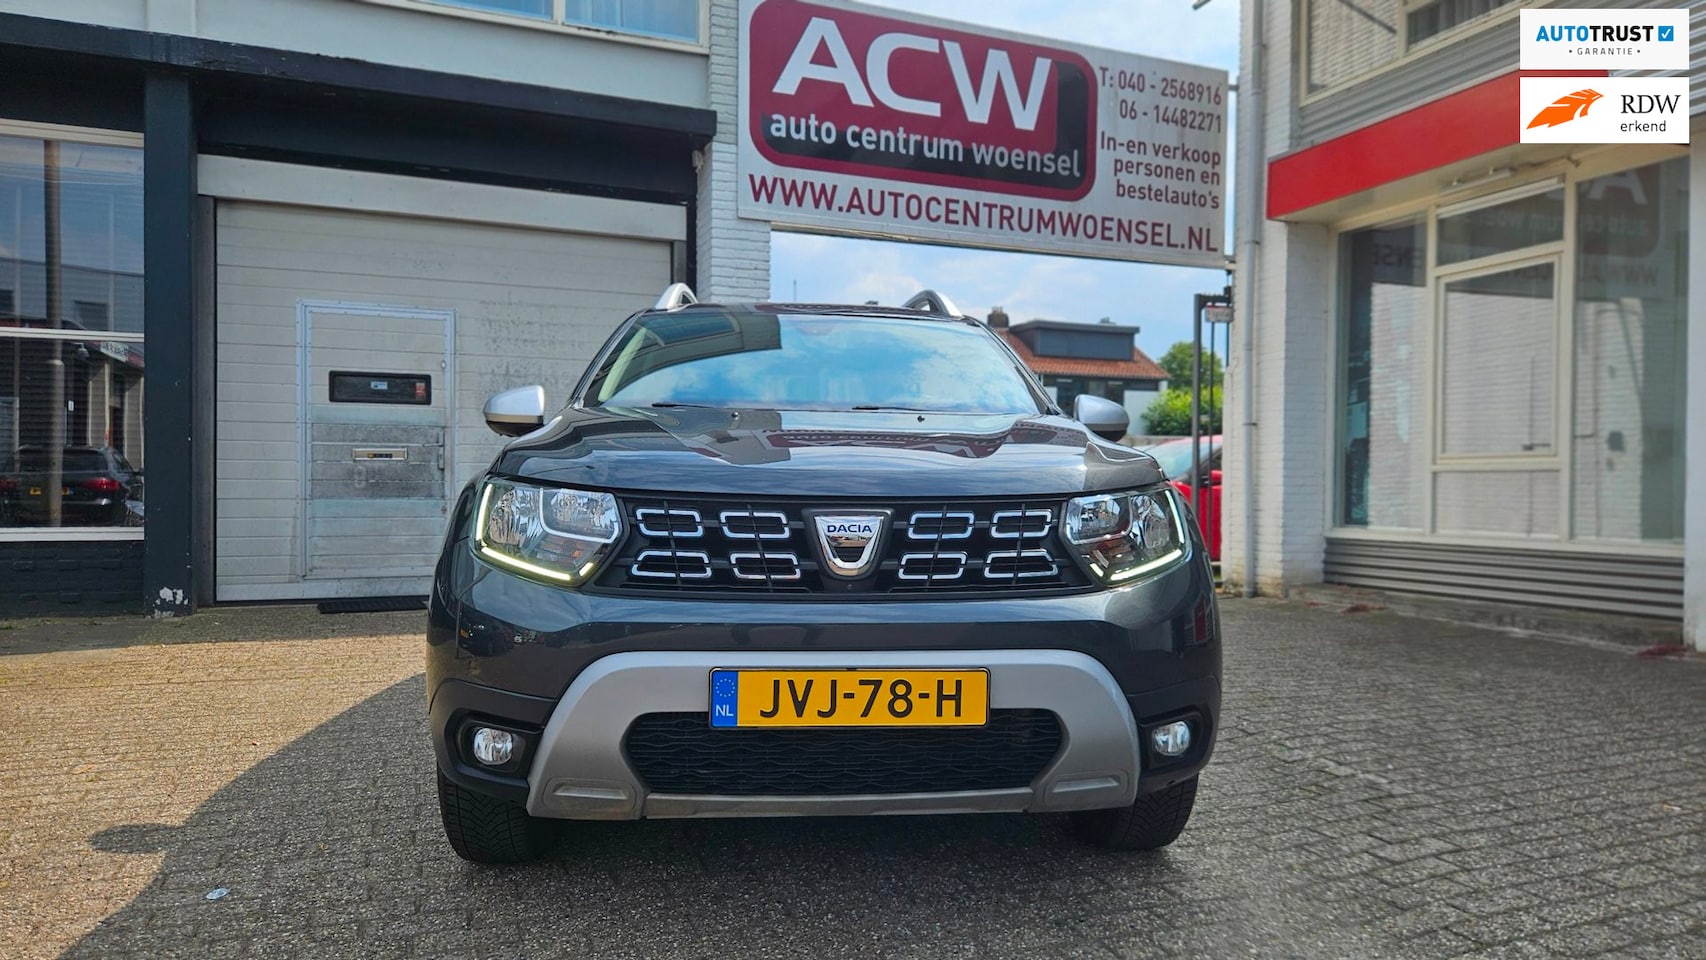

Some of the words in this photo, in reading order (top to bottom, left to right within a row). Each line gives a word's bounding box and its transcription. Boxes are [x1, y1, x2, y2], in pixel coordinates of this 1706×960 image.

[771, 16, 1053, 132] ACW
[1118, 70, 1146, 93] 040
[1161, 77, 1222, 106] 2568916
[1119, 98, 1138, 121] 06
[1154, 104, 1222, 134] 14482271
[770, 111, 838, 146] auto
[845, 120, 965, 164] centrum
[972, 142, 1082, 179] woensel
[1100, 130, 1147, 156] In-en
[1151, 143, 1222, 170] verkoop
[1113, 158, 1196, 183] personen
[1200, 169, 1220, 186] en
[1115, 178, 1220, 210] bestelauto's
[748, 172, 1219, 254] WWW.AUTOCENTRUMWOENSEL.NL
[826, 523, 873, 534] DACIA
[715, 704, 734, 717] NL
[759, 679, 962, 719] JVJ-78-H
